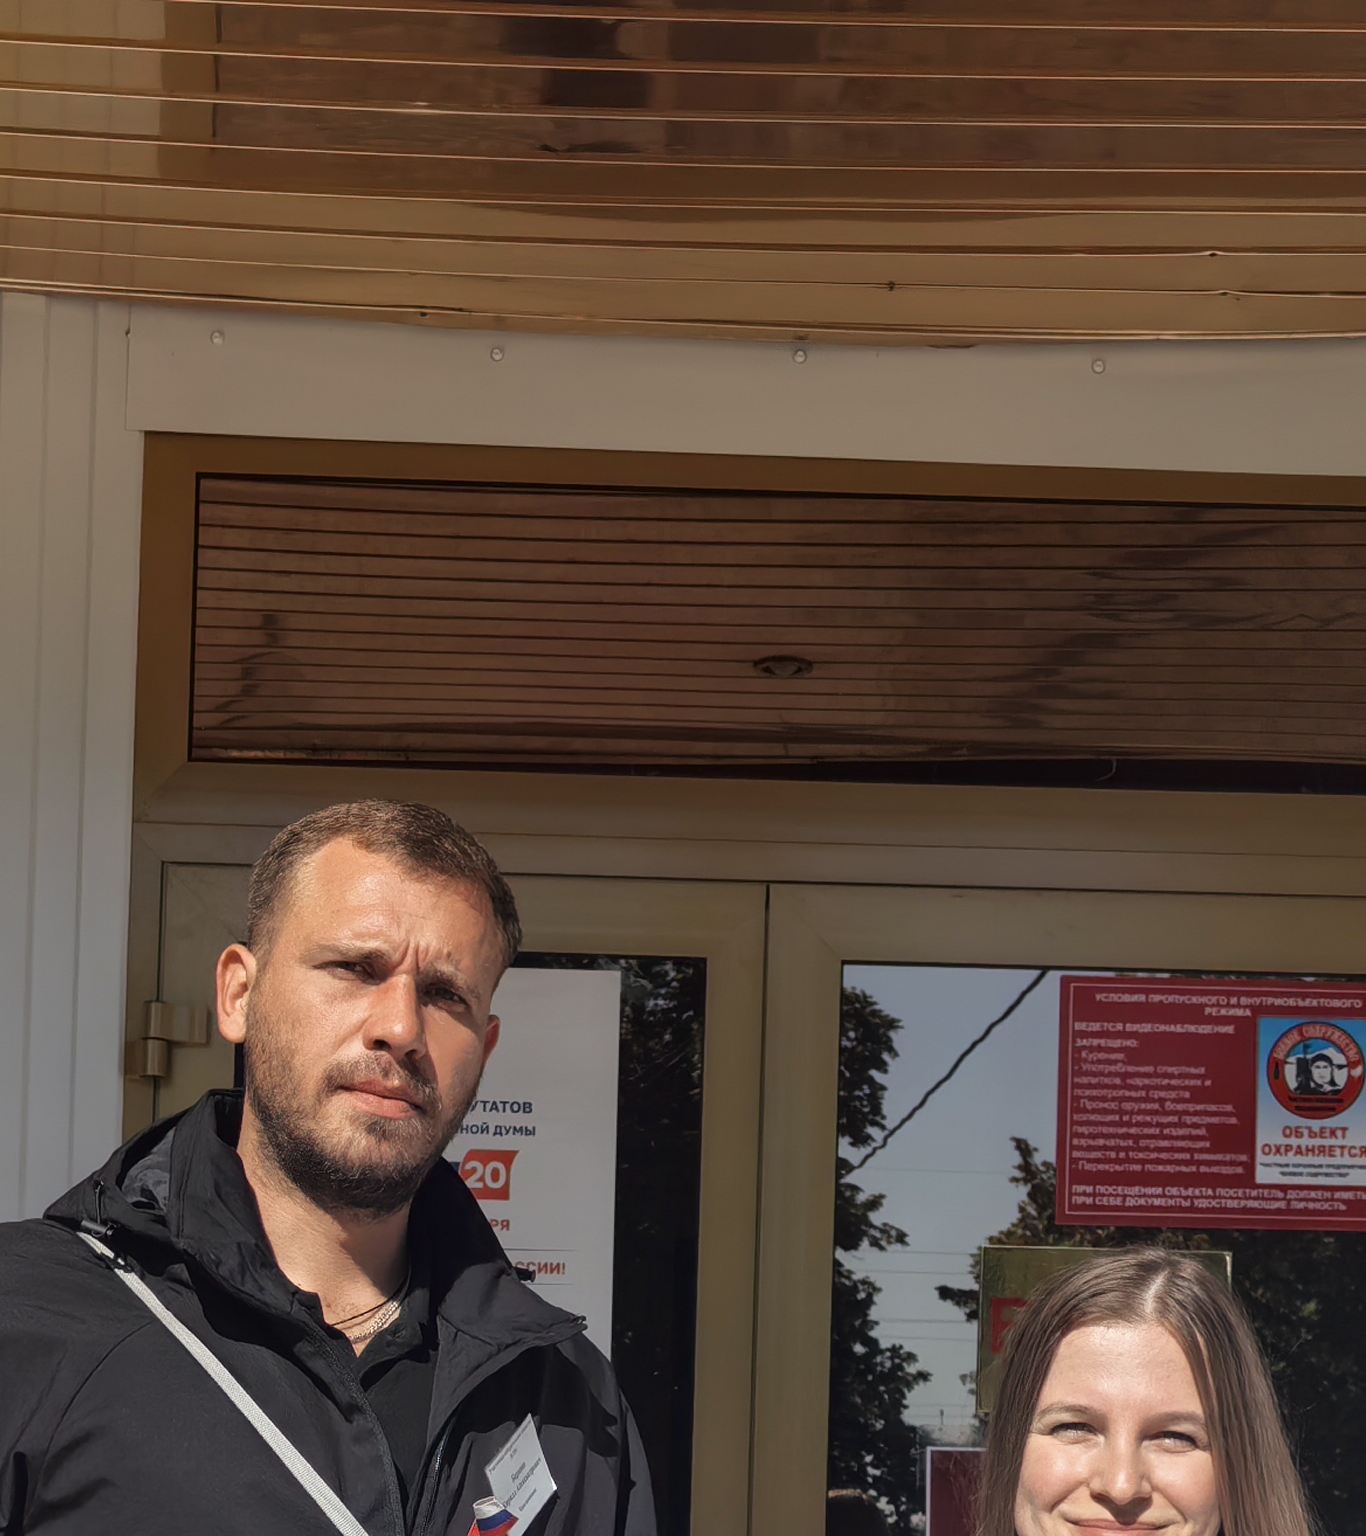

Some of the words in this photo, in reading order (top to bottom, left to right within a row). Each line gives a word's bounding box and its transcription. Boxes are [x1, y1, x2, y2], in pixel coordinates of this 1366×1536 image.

[492, 1125, 536, 1137] ДУМЫ
[1282, 1125, 1349, 1140] ОБЪЕКТ
[464, 1160, 507, 1189] 20
